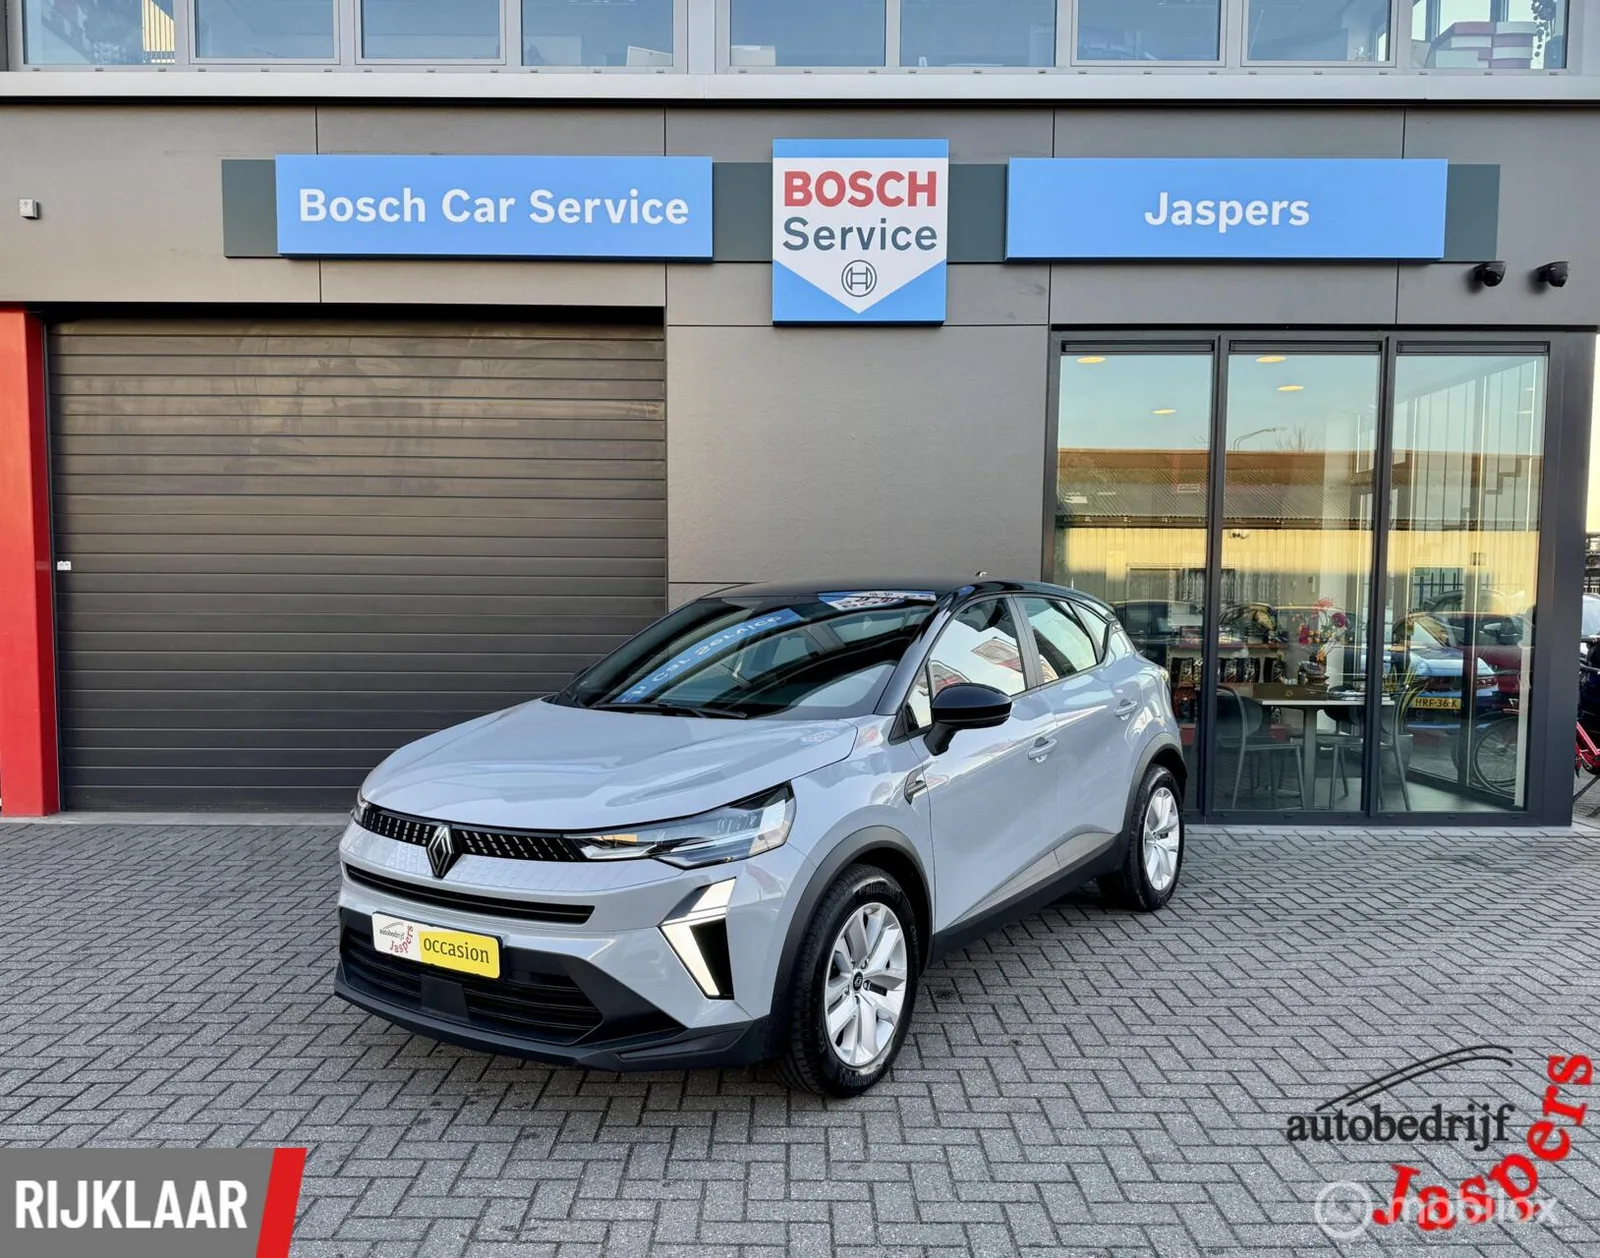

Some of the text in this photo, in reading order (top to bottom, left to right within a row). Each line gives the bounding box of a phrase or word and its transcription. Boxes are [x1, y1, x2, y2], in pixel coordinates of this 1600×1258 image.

[300, 188, 689, 225] Bosch Car Service
[784, 170, 937, 207] BOSCH
[1144, 192, 1310, 233] Jaspers
[783, 216, 938, 251] Service
[389, 925, 414, 954] Jaspers
[423, 937, 490, 964] occasion
